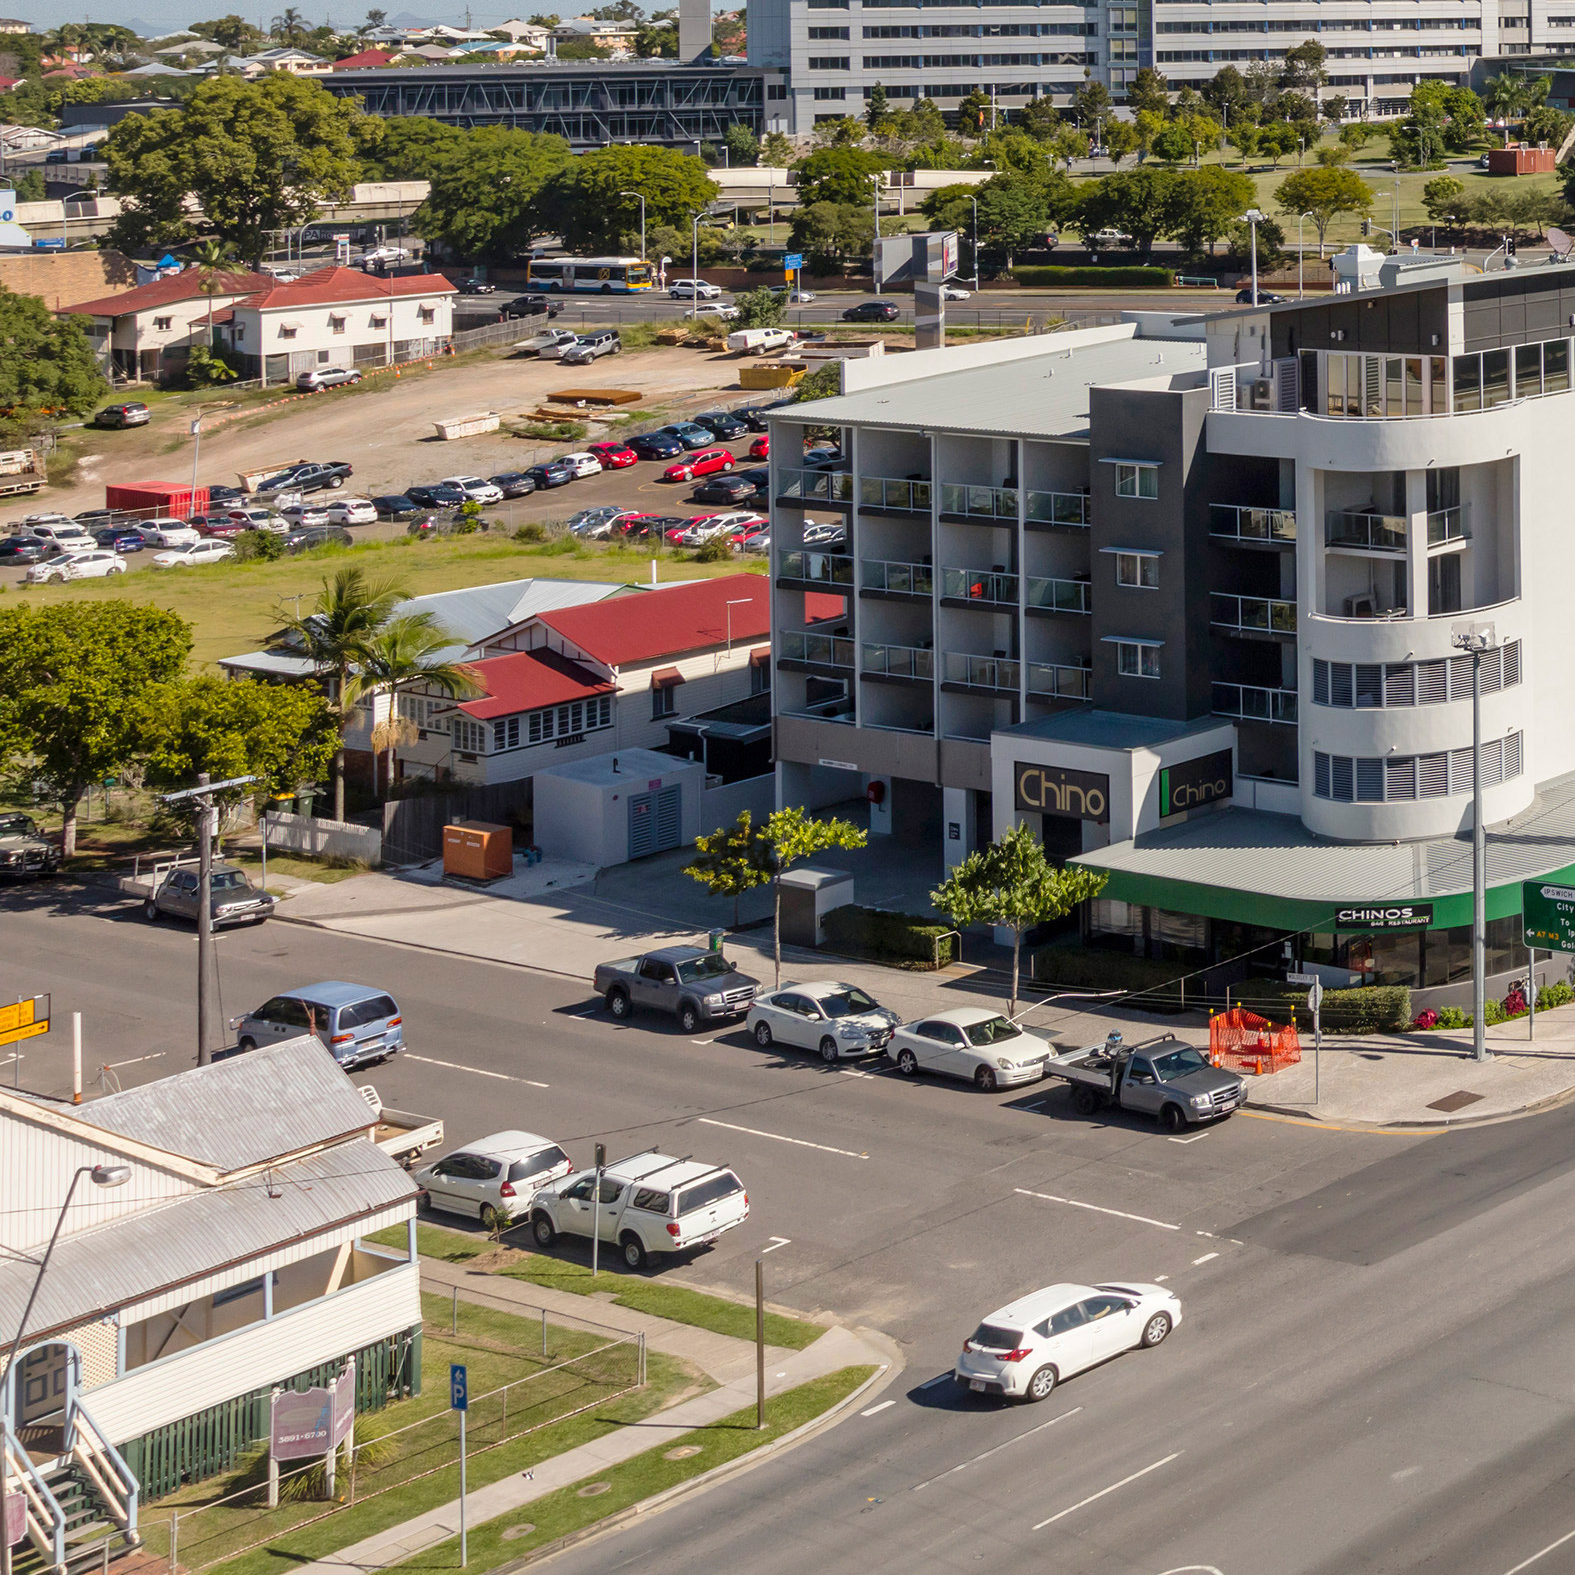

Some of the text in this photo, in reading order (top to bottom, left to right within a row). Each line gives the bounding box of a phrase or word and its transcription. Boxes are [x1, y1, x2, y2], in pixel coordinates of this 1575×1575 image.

[304, 230, 319, 240] PA
[1019, 769, 1105, 816] Chino
[1173, 779, 1226, 806] Chino
[1544, 888, 1573, 898] IPSWICH
[1556, 902, 1574, 913] City
[1339, 908, 1413, 921] CHINOS
[1388, 918, 1430, 926] RESTAURANT
[1560, 918, 1570, 926] To
[1548, 932, 1559, 940] M3
[454, 1384, 464, 1405] P
